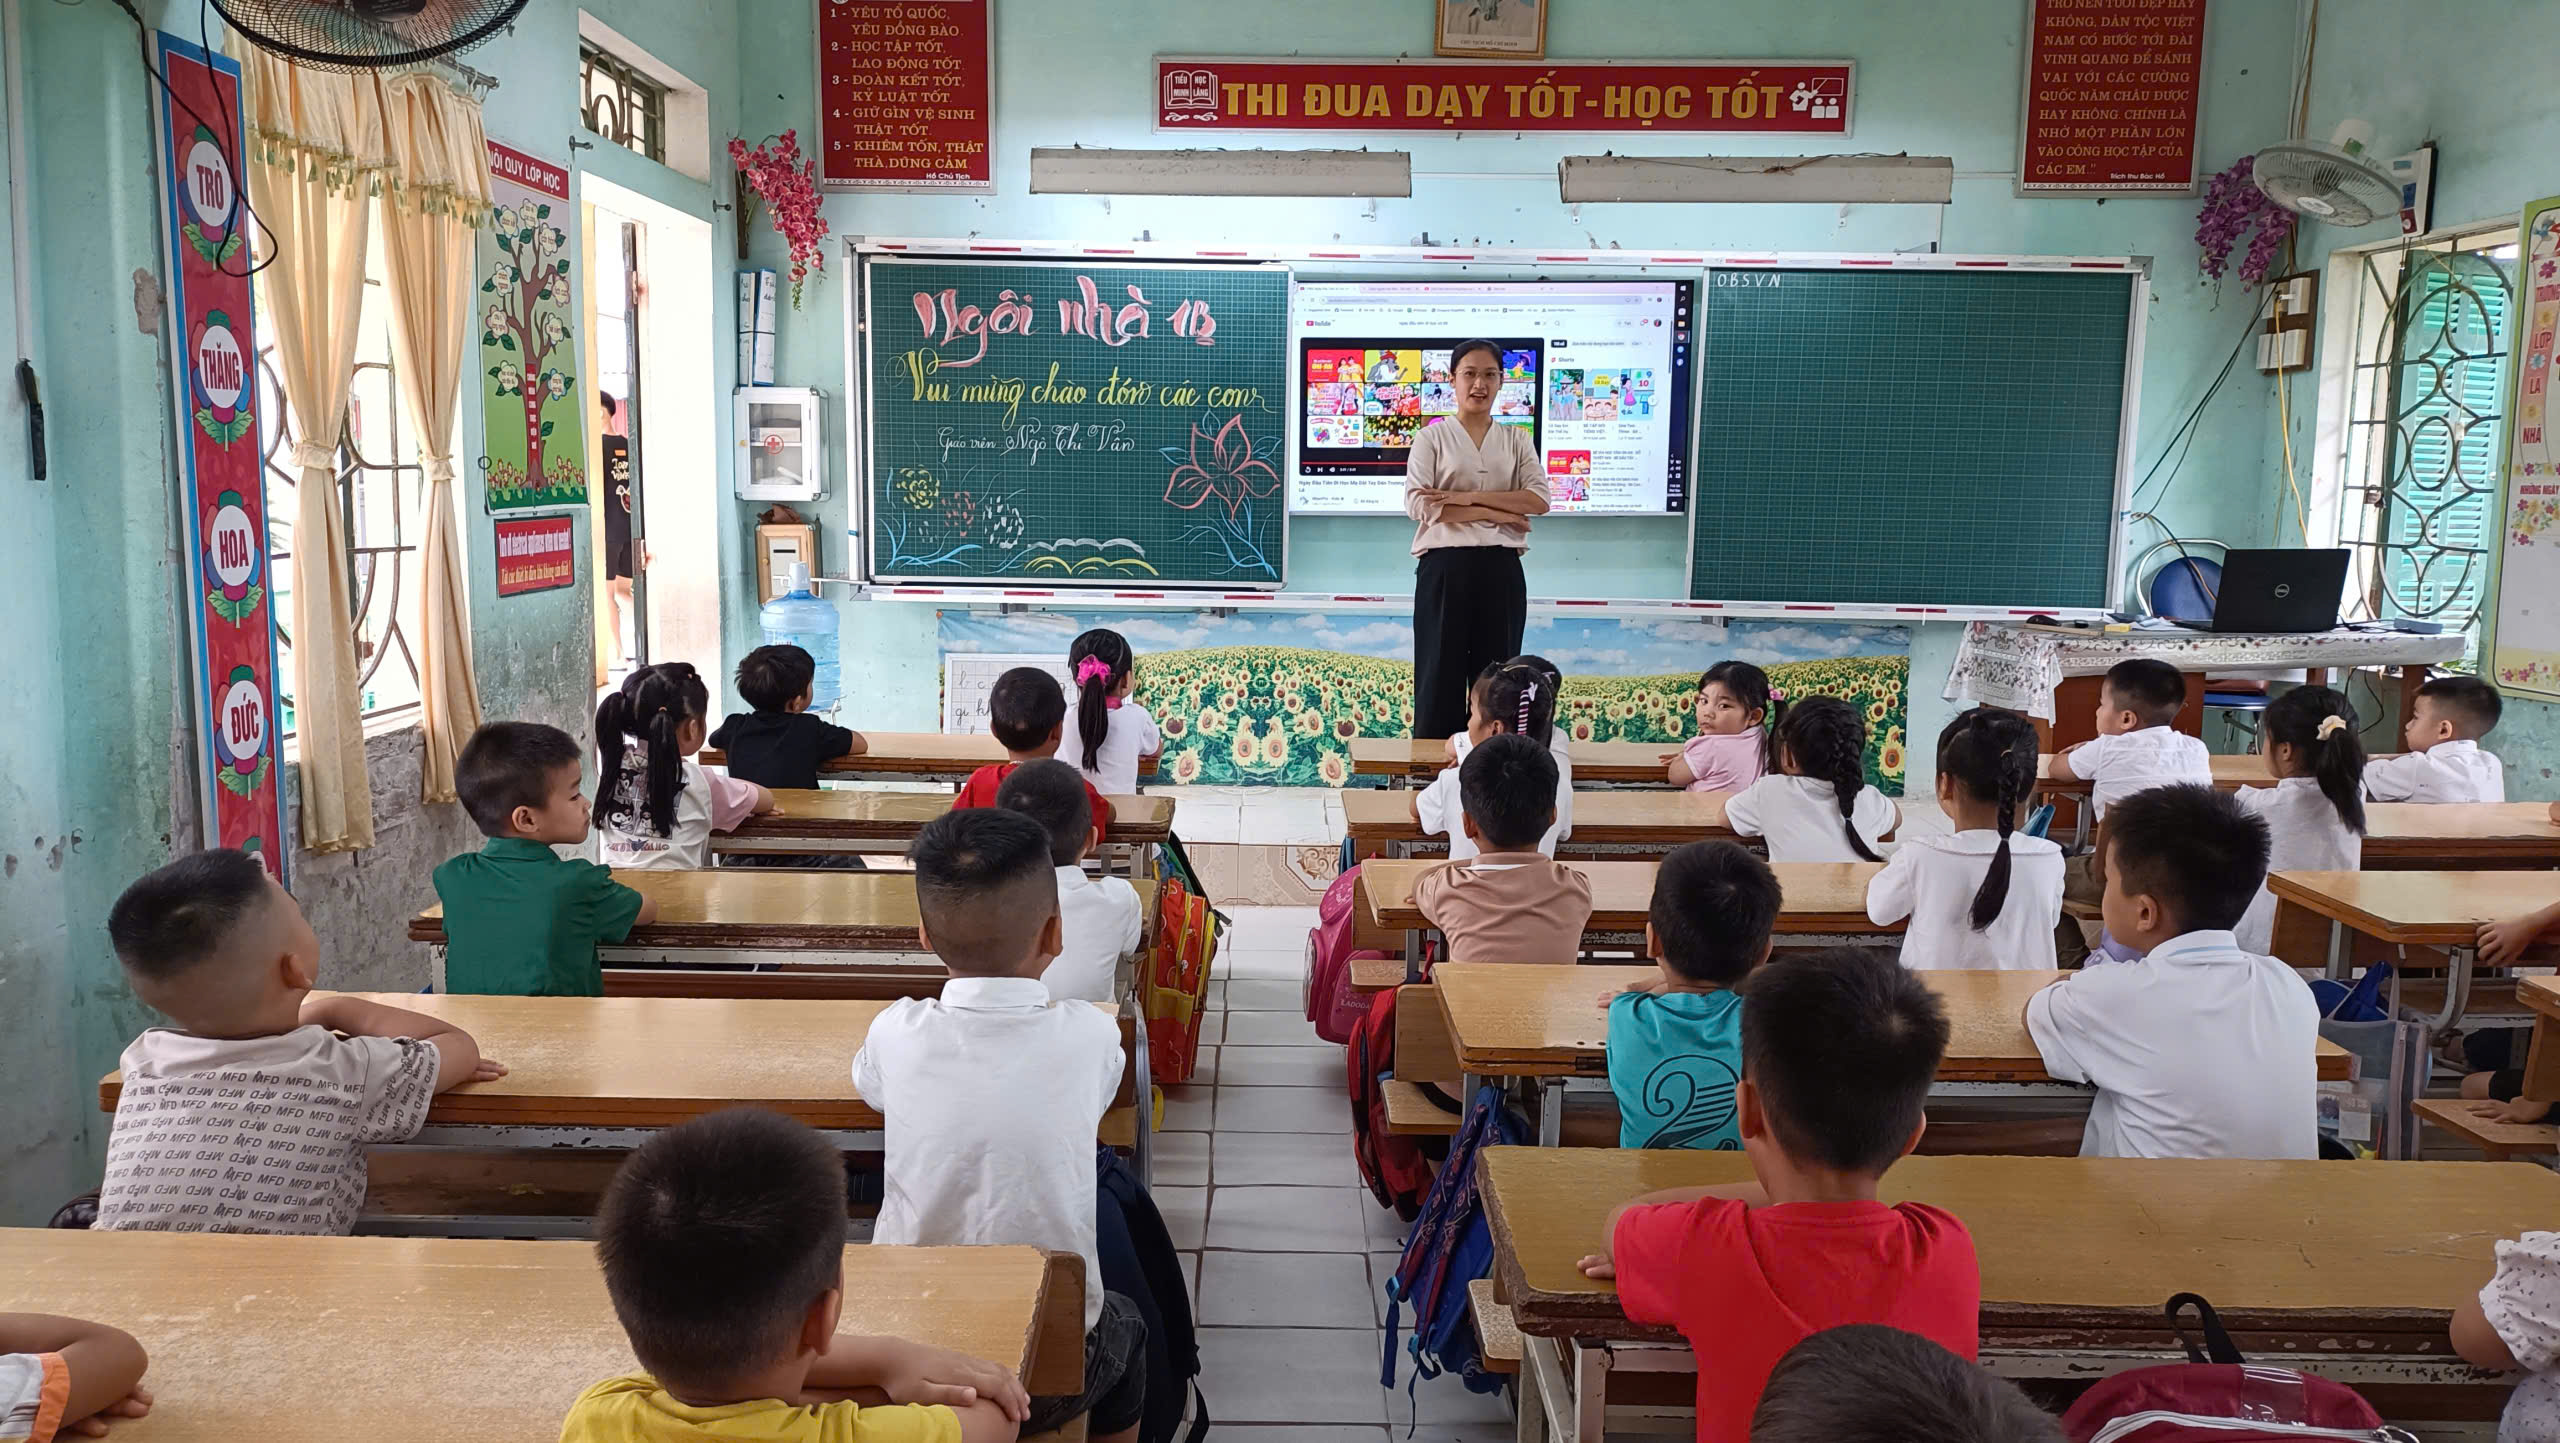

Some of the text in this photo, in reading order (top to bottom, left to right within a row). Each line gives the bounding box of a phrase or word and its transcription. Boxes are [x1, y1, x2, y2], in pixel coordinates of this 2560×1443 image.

[831, 9, 836, 17] 1
[851, 6, 880, 18] YÊU
[851, 23, 880, 35] YÊU
[2101, 15, 2129, 27] DÂN
[2134, 14, 2160, 28] TỘC
[2164, 14, 2195, 28] VIỆT
[831, 42, 838, 50] 2
[851, 41, 880, 53] HỌC
[884, 40, 912, 53] TẬP
[2044, 32, 2193, 46] NAM CÓ BƯỚC TỚI ĐÀI
[852, 59, 882, 68] LAO
[886, 56, 928, 70] ĐỘNG
[2043, 54, 2077, 64] VINH
[2081, 54, 2129, 65] QUANG
[2154, 51, 2192, 64] SÁNH
[832, 75, 839, 83] 3
[852, 73, 894, 85] ĐOÀN
[900, 72, 928, 86] KẾT
[2042, 73, 2067, 83] VAI
[2075, 70, 2100, 83] VỚI
[2107, 70, 2135, 83] CÁC
[879, 90, 917, 104] LUẬT
[1222, 83, 1288, 116] THI
[1303, 84, 1391, 117] ĐUA
[1406, 84, 1491, 125] DẠY
[1706, 70, 1784, 119] TỐT
[2040, 88, 2076, 102] QUỐC
[833, 109, 840, 117] 4
[883, 106, 910, 118] GÌN
[915, 107, 935, 121] VỆ
[938, 110, 976, 119] SINH
[2040, 110, 2067, 120] HAY
[2124, 107, 2167, 120] CHÍNH
[2170, 107, 2186, 119] LÀ
[854, 122, 893, 137] THẬT
[2074, 126, 2106, 140] MỘT
[834, 142, 840, 150] 5
[854, 139, 903, 151] KHIÊM
[945, 140, 983, 155] THẬT
[2038, 142, 2183, 158] VÀO CÔNG HỌC TẬP CỦA
[505, 157, 523, 176] QUY
[525, 162, 541, 183] LỚP
[544, 171, 560, 193] HỌC
[2036, 162, 2062, 174] CÁC
[196, 160, 224, 210] TRÒ
[913, 275, 1217, 367] Ngôi nhà 1B
[2534, 327, 2552, 349] LỚP
[202, 341, 241, 391] THĂNG
[884, 347, 1278, 431] Vui mừng chào đón các con
[970, 437, 996, 449] viên
[1000, 417, 1047, 466] Ngô
[1088, 419, 1135, 452] Vân
[218, 529, 249, 569] HOA
[231, 693, 260, 745] ĐỨC
[221, 1071, 311, 1087] MFD MFD MFD
[211, 1102, 304, 1118] MFD MFD MFD
[201, 1134, 295, 1151] MFD MFD
[190, 1168, 284, 1186] MFD MFD
[180, 1204, 275, 1221] MFD MFD
